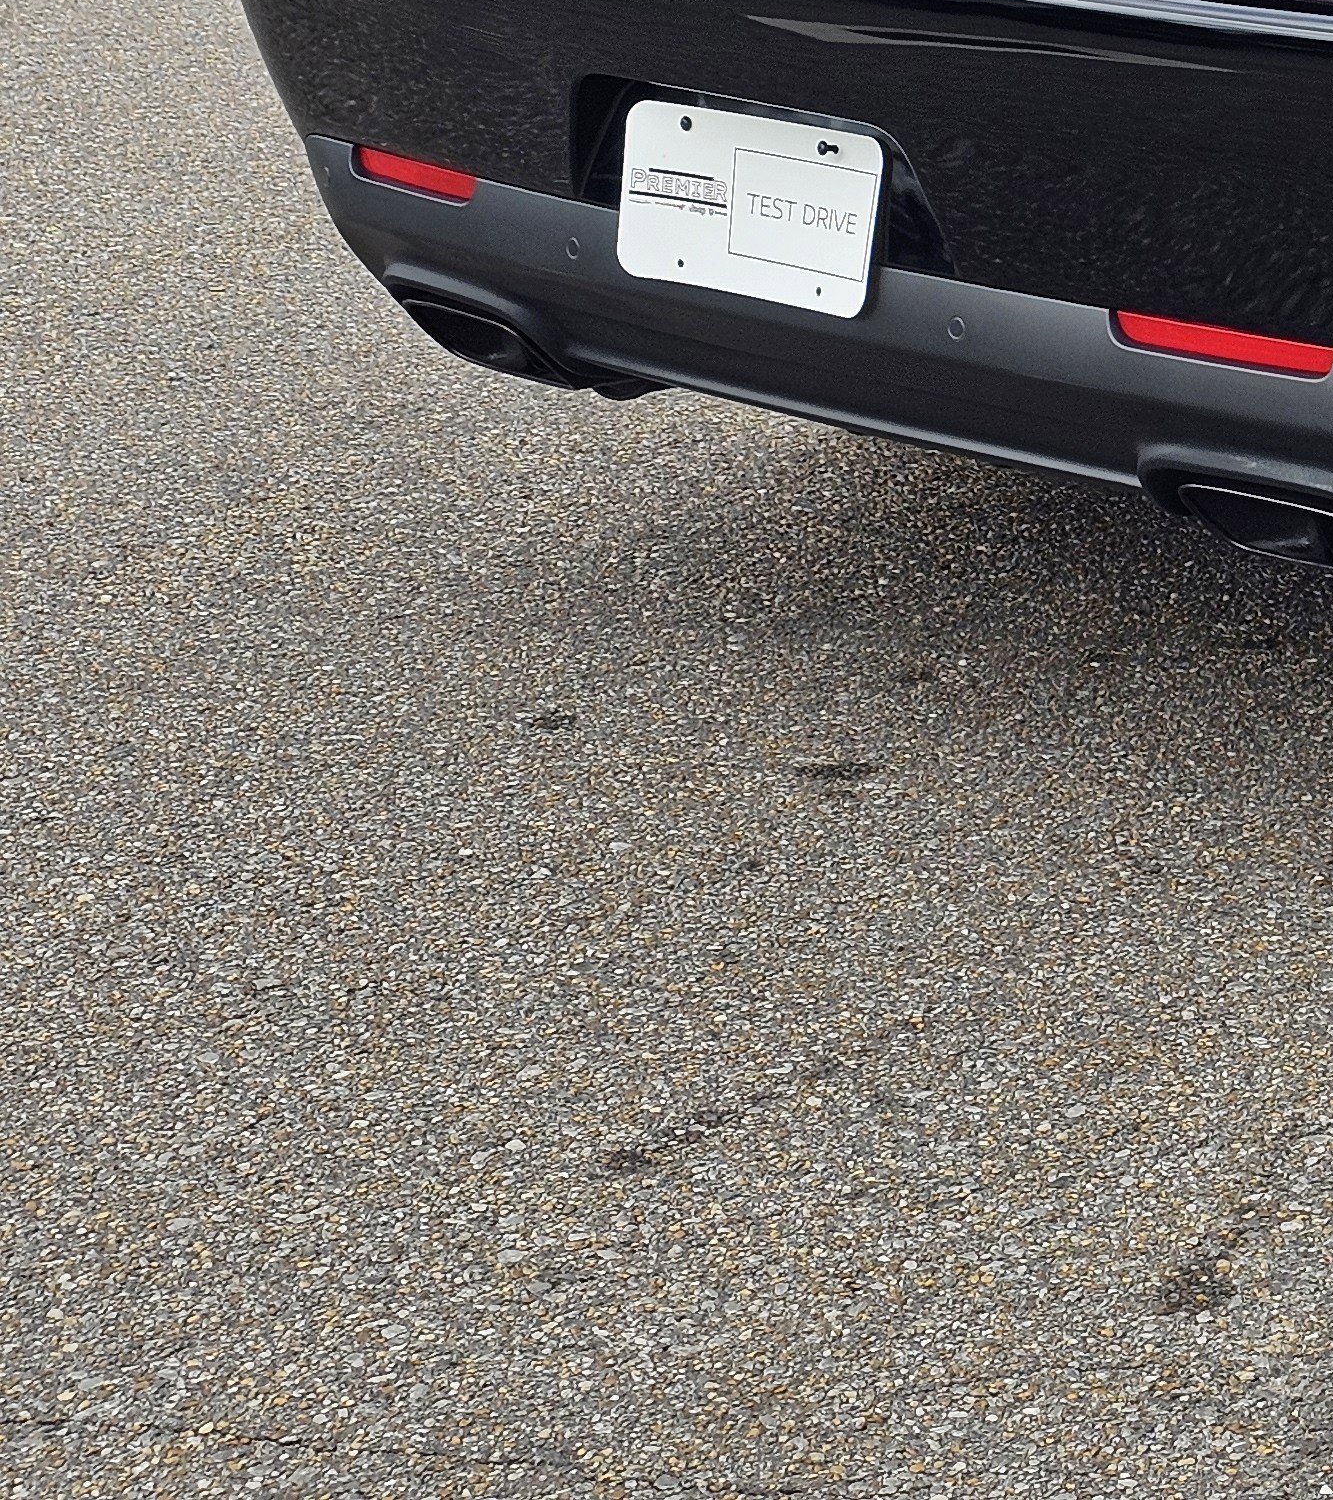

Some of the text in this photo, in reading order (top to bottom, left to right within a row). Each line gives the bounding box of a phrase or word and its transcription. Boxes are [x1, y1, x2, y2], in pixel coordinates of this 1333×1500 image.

[629, 167, 728, 203] PREMIER
[746, 192, 798, 222] TEST
[802, 203, 858, 235] DRIVE
